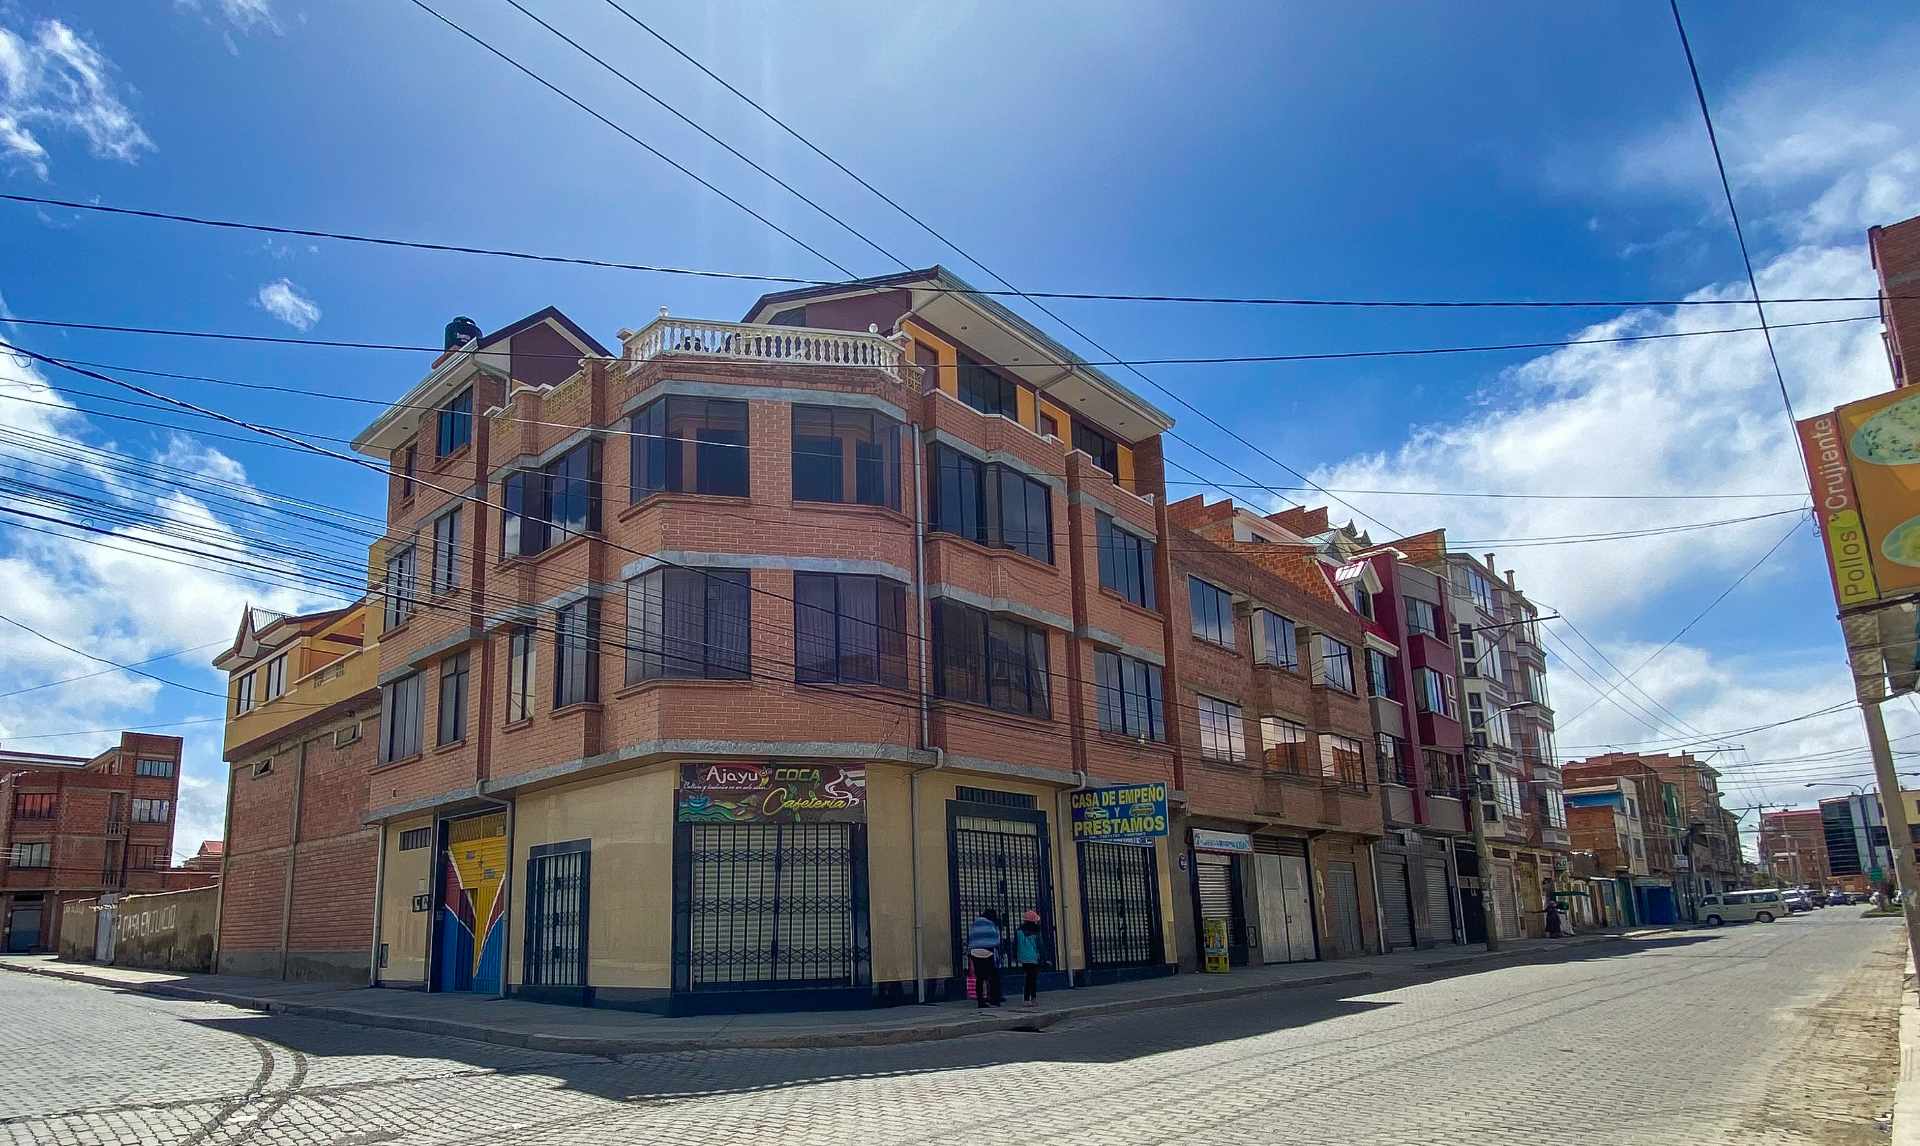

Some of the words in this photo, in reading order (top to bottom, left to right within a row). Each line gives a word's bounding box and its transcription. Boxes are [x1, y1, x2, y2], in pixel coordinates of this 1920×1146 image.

[1812, 417, 1848, 510] Crujiente
[1839, 530, 1868, 598] Pollos
[706, 766, 760, 784] Ajayu
[774, 768, 821, 783] COCA
[1072, 792, 1100, 808] CASA
[1102, 790, 1116, 806] DE
[1118, 784, 1165, 805] EMPEÑO
[1114, 807, 1120, 818] Y
[1073, 815, 1165, 837] PRESTAMOS
